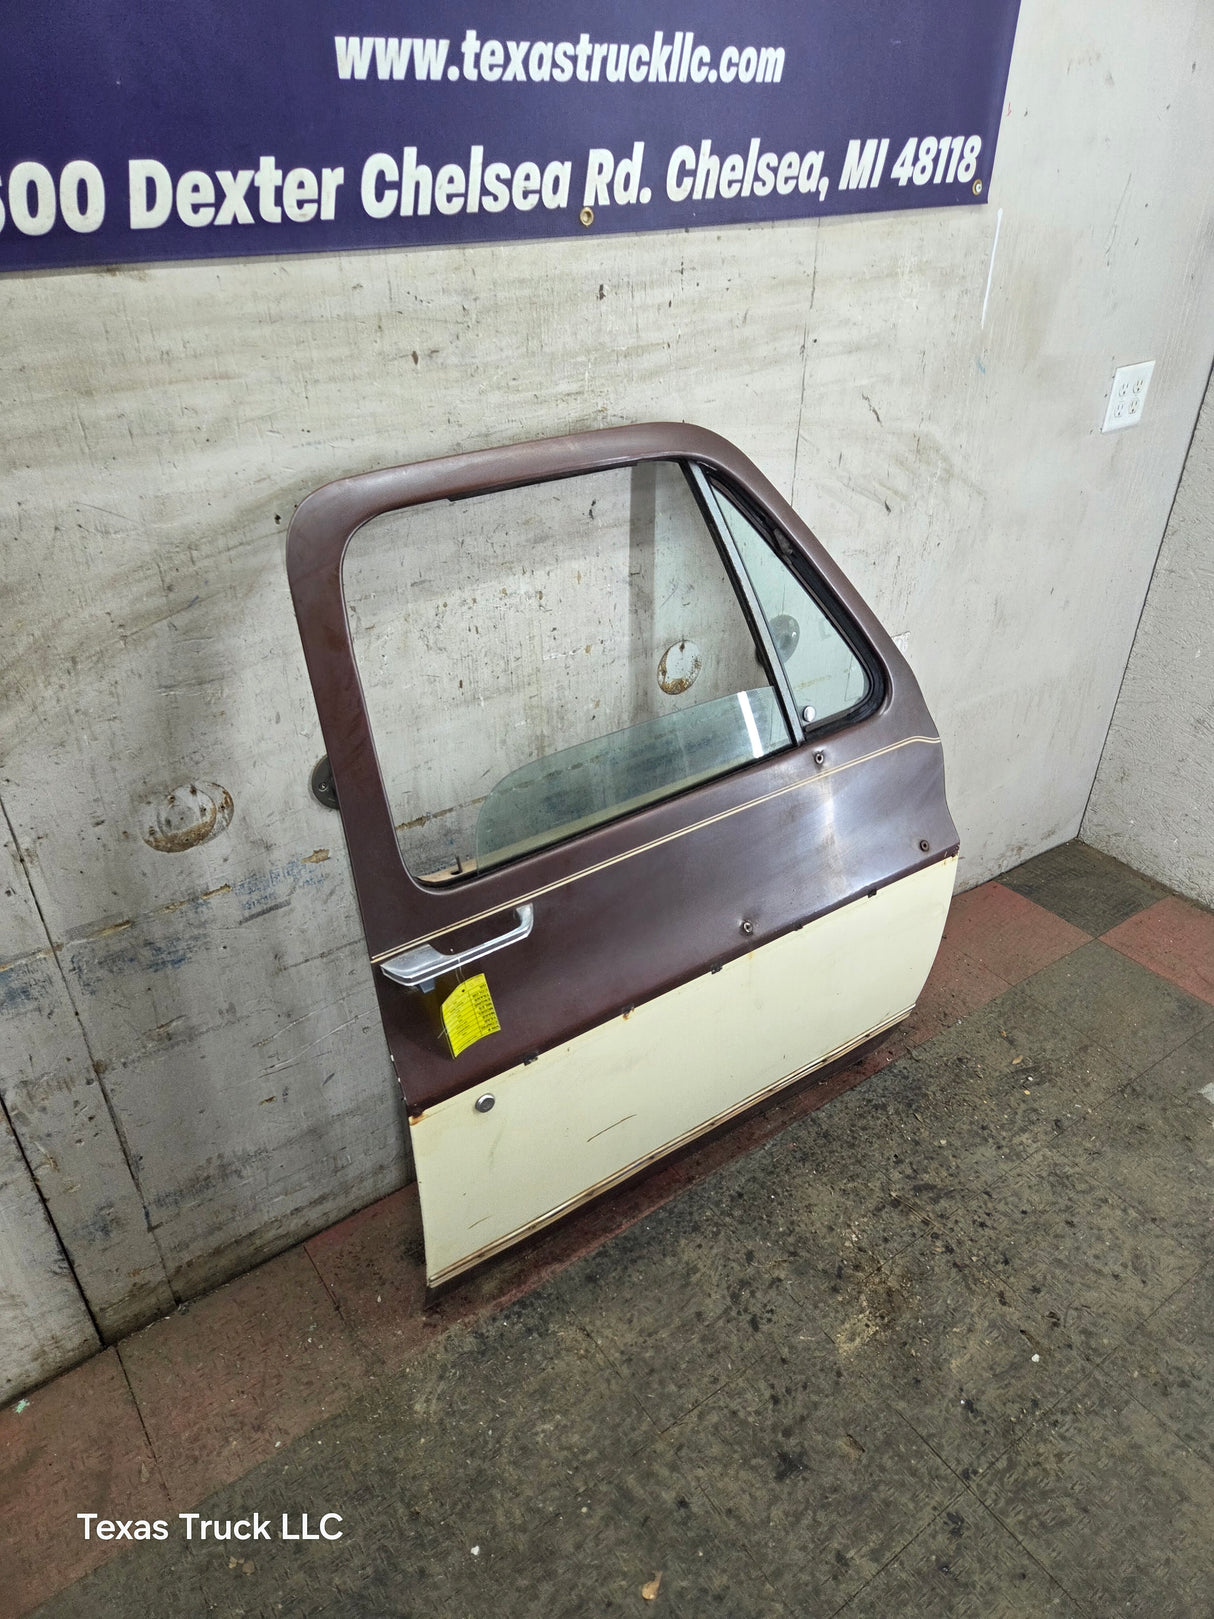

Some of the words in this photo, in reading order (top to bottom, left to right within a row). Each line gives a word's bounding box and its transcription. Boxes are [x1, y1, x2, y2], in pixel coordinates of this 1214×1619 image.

[334, 29, 786, 84] www.texastruckllc.com
[0, 160, 106, 236] 00
[128, 155, 345, 230] Dexter
[360, 144, 573, 220] Chelsea
[583, 140, 652, 207] Rd.
[666, 137, 830, 203] Chelsea,
[837, 137, 891, 191] MI
[890, 134, 982, 187] 48118
